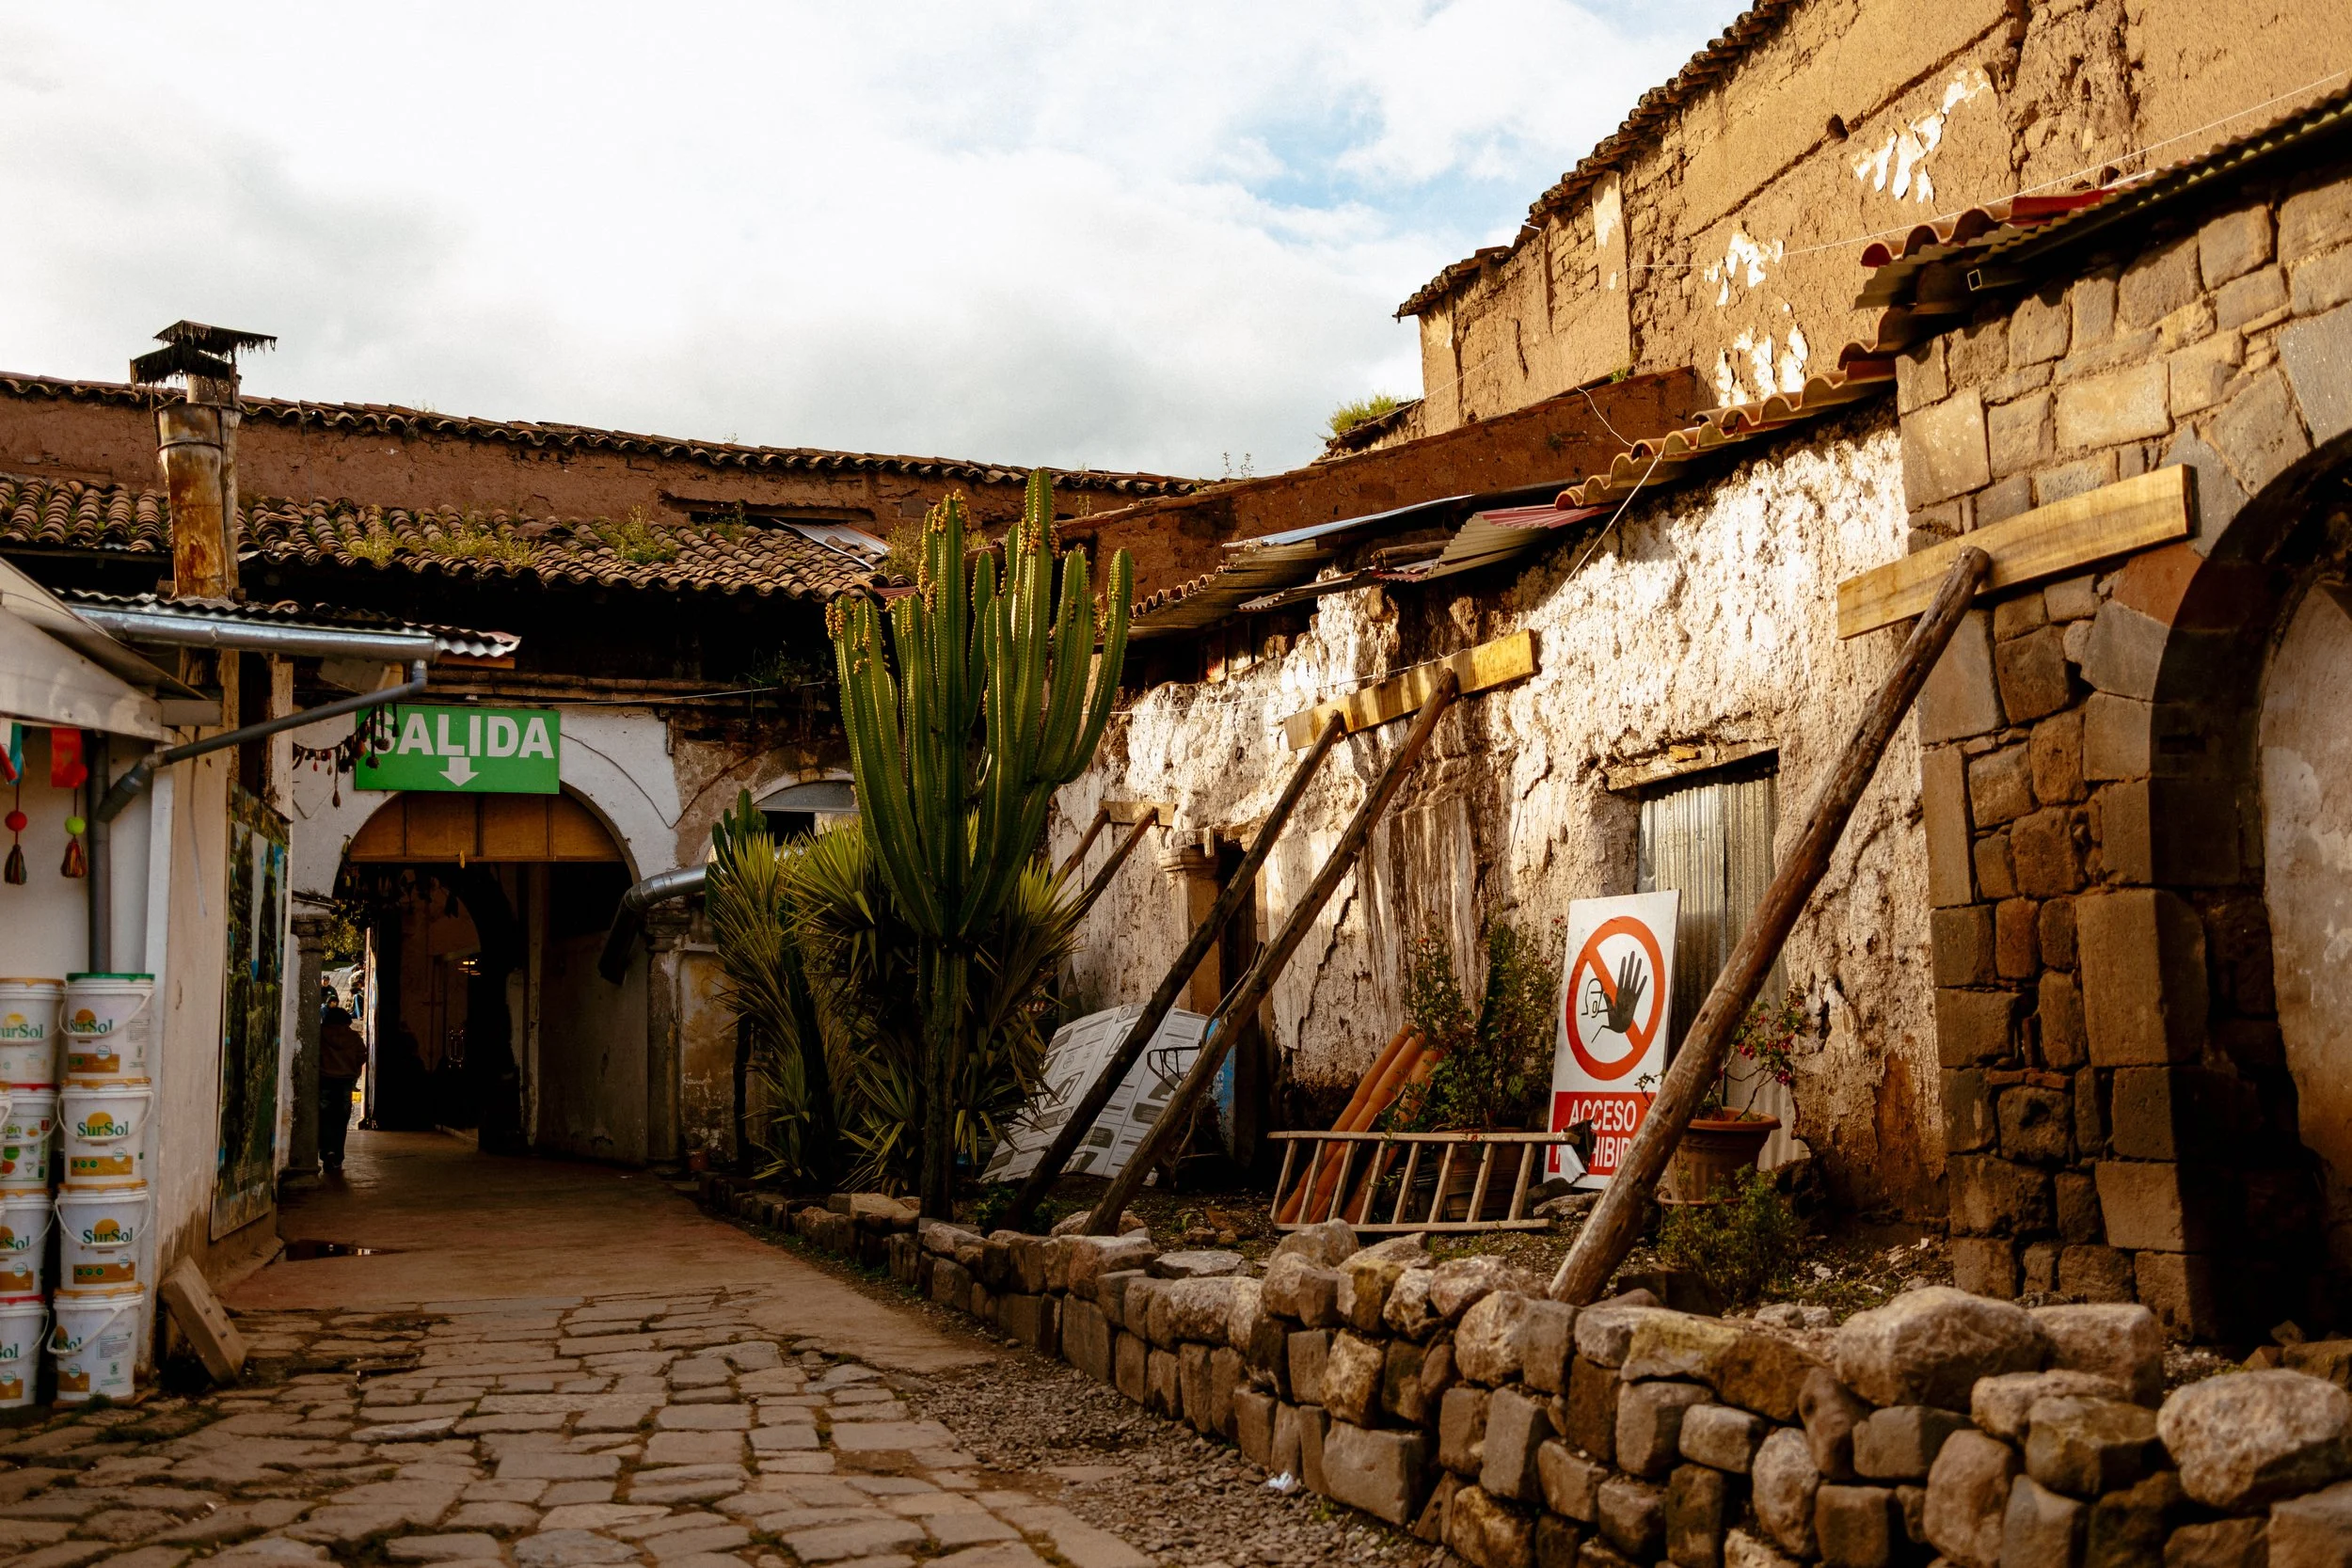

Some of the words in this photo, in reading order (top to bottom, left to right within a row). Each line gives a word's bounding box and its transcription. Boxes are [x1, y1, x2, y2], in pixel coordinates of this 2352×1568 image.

[365, 711, 555, 759] SALIDA
[0, 1023, 43, 1038] urSol
[1568, 1100, 1637, 1132] ACCESO
[77, 1121, 129, 1137] SurSol
[83, 1227, 133, 1244] SurSol
